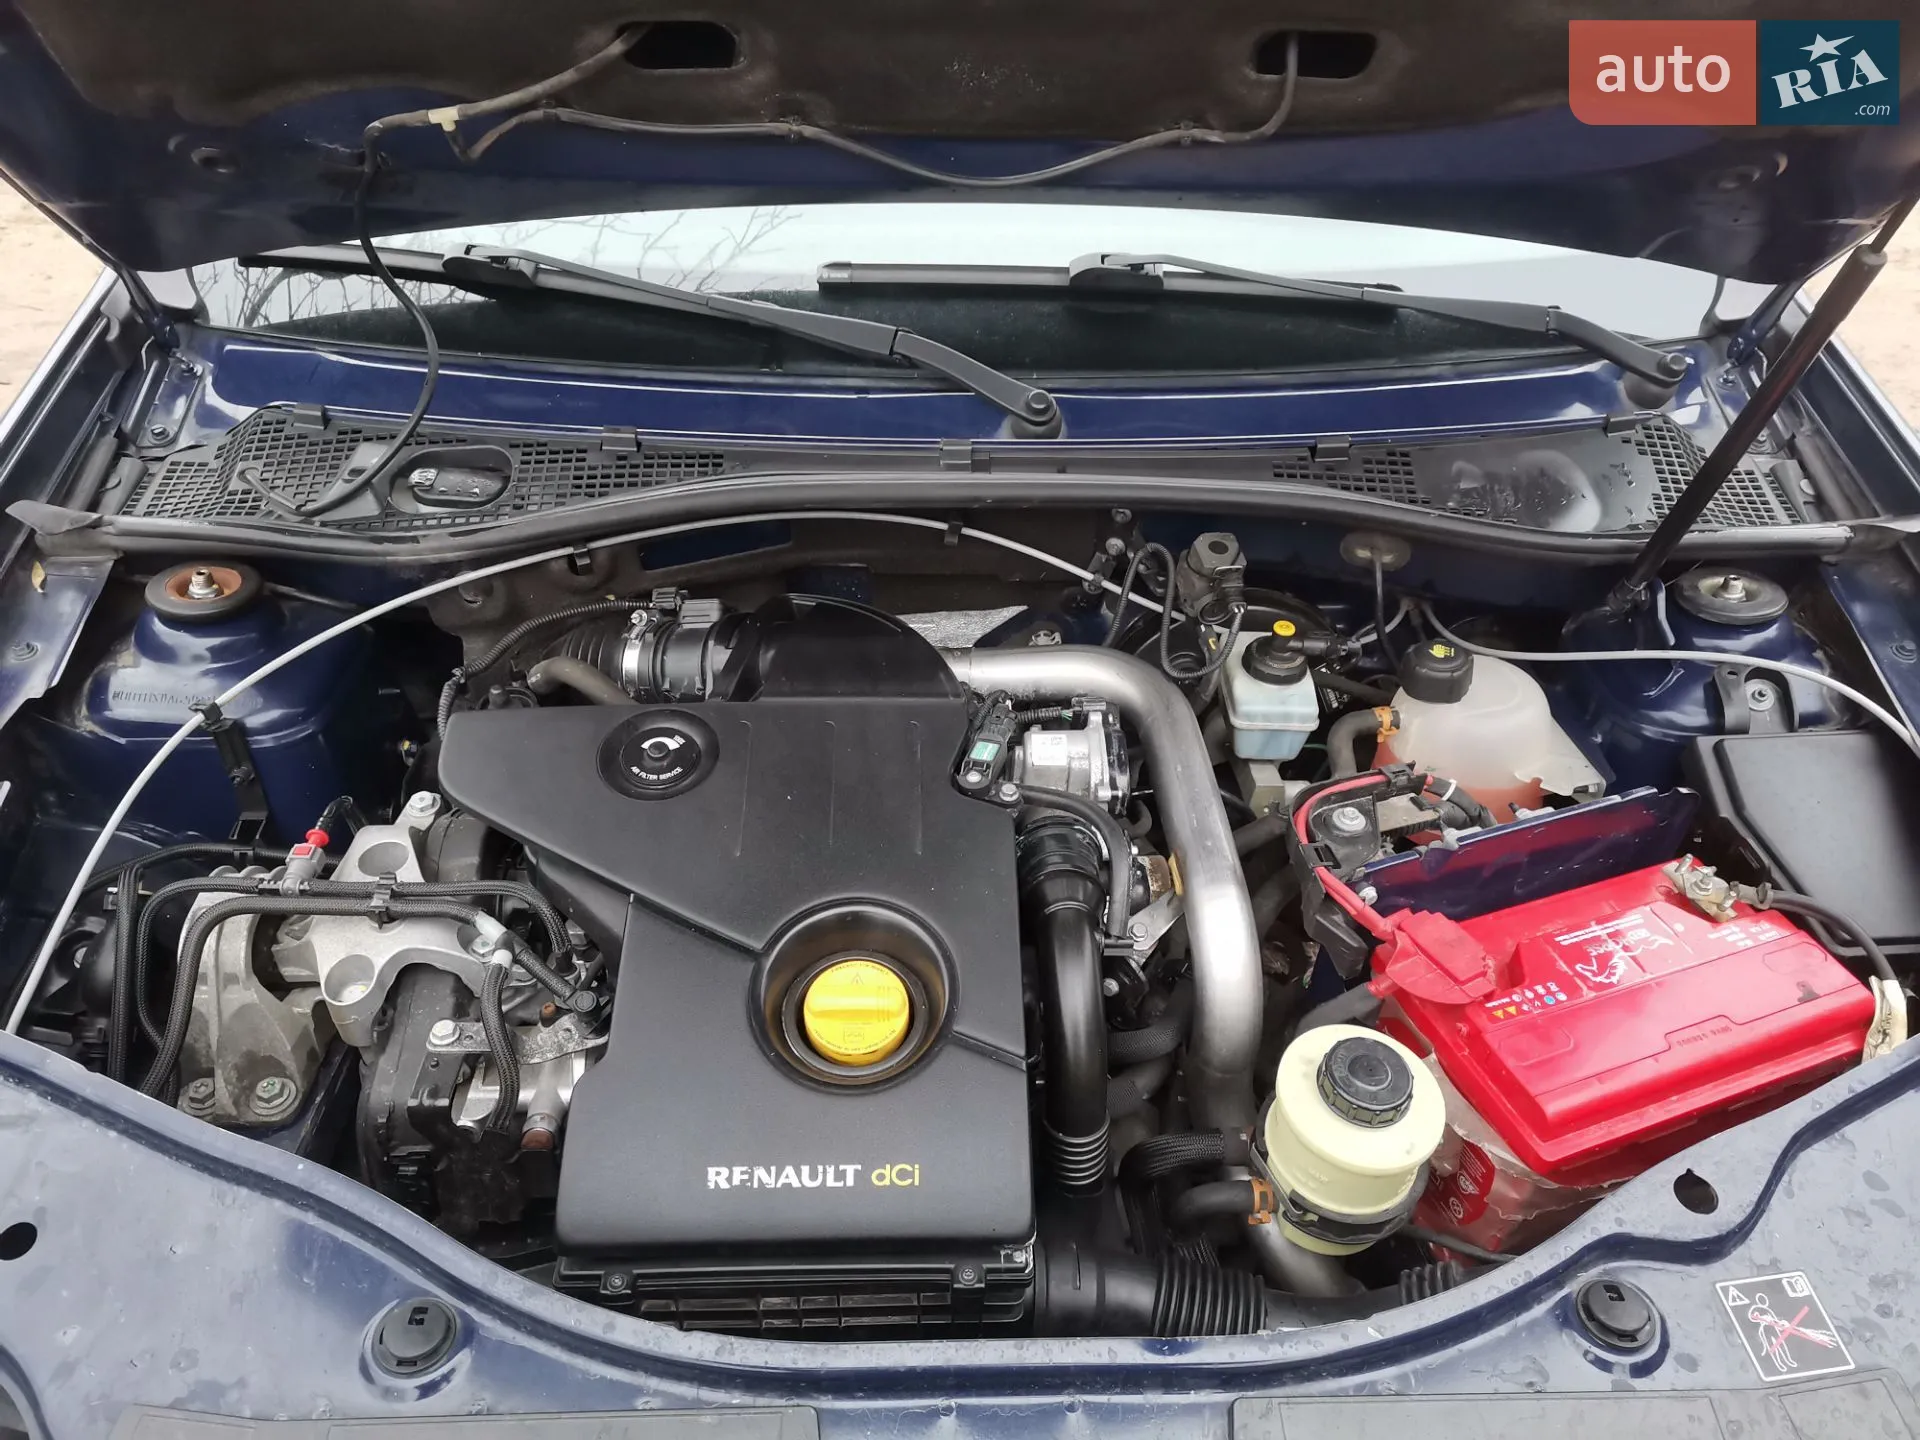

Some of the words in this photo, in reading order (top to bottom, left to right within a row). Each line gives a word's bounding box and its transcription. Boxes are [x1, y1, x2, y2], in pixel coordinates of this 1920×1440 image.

[630, 766, 640, 775] AIR
[639, 771, 658, 780] FILTER
[659, 766, 683, 780] SERVICE
[707, 1164, 862, 1189] RENAULT
[871, 1163, 920, 1187] dCi
